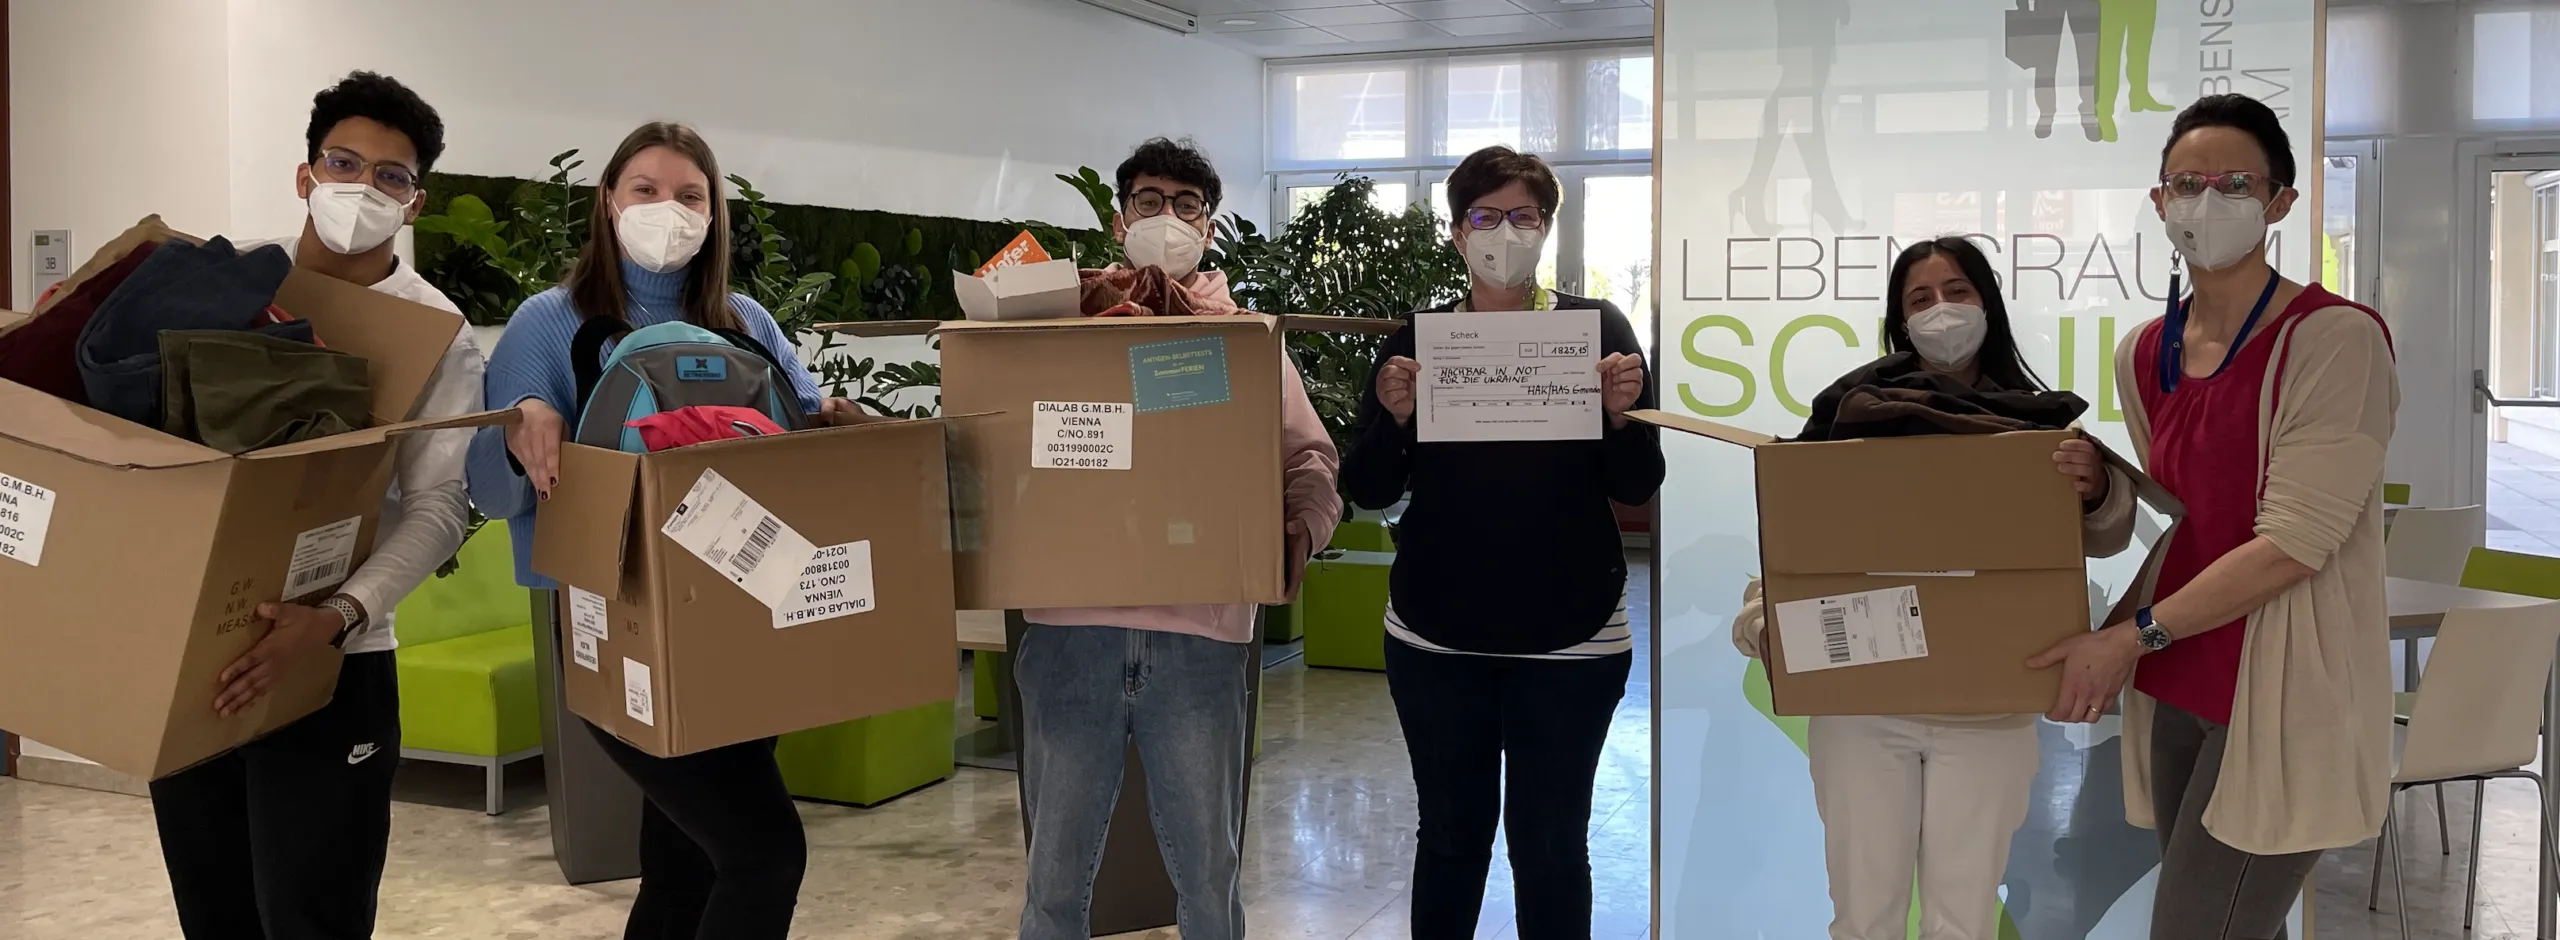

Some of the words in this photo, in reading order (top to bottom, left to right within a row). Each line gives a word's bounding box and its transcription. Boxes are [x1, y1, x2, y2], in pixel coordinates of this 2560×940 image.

[1682, 230, 2282, 301] LEBERAU
[1450, 331, 1479, 339] Scheck
[1440, 366, 1487, 377] NACHBAR
[1515, 365, 1546, 375] NOT
[1462, 376, 1481, 384] DIE
[1483, 374, 1530, 384] UKRAINE
[1038, 402, 1078, 413] DIALAB
[1081, 404, 1126, 414] G.M.B.H.
[1061, 416, 1102, 427] VIENNA
[1047, 443, 1114, 453] 0031990002C
[800, 559, 849, 576] 00318800
[805, 589, 843, 603] VIENNA
[828, 598, 866, 613] DIALAB
[352, 742, 374, 756] NIKE
